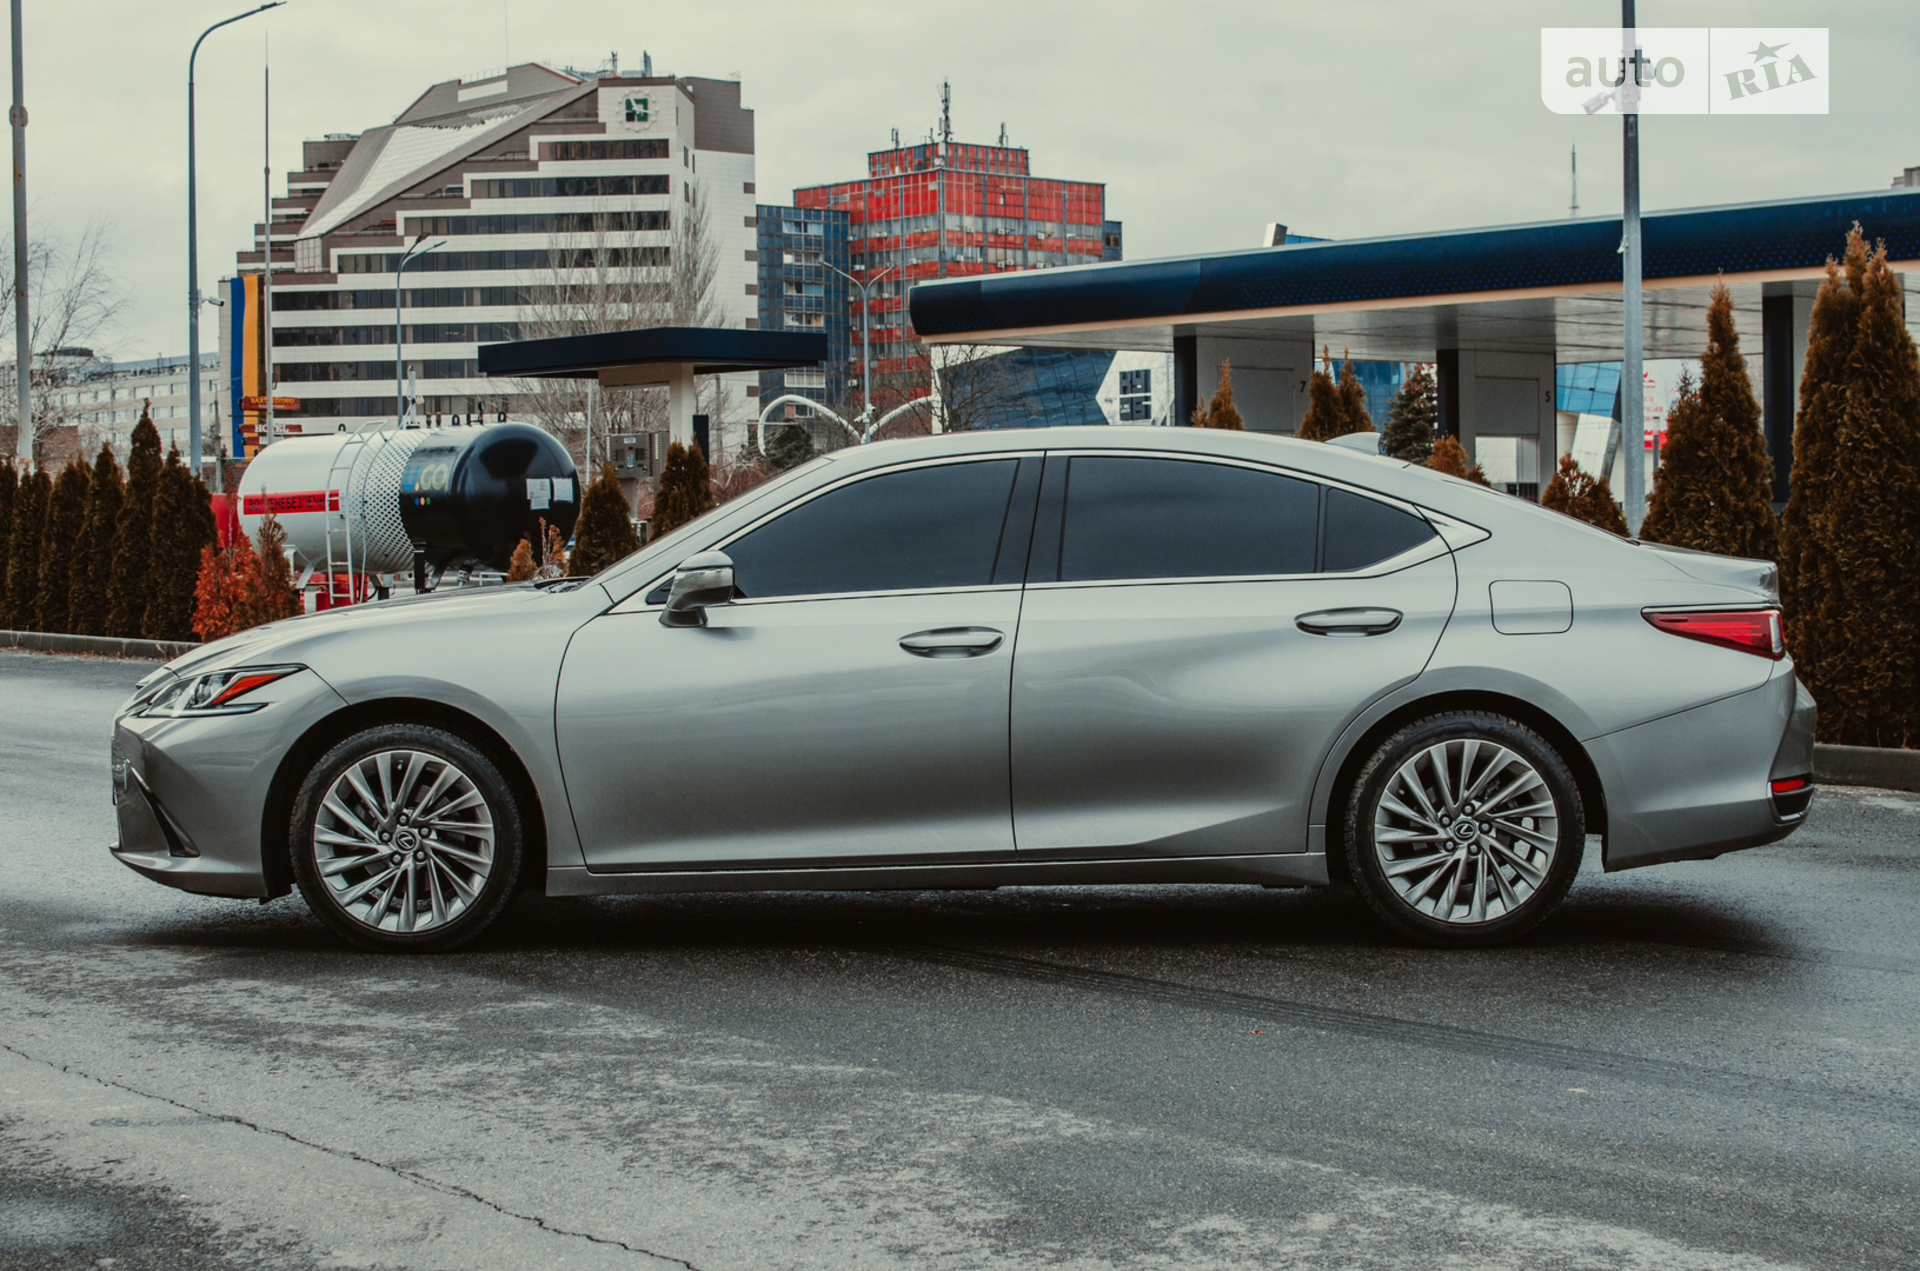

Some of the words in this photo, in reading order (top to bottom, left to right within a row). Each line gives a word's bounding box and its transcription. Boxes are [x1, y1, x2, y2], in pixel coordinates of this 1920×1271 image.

[1299, 380, 1307, 394] 7
[1544, 390, 1551, 403] 5
[254, 424, 289, 433] HOEL
